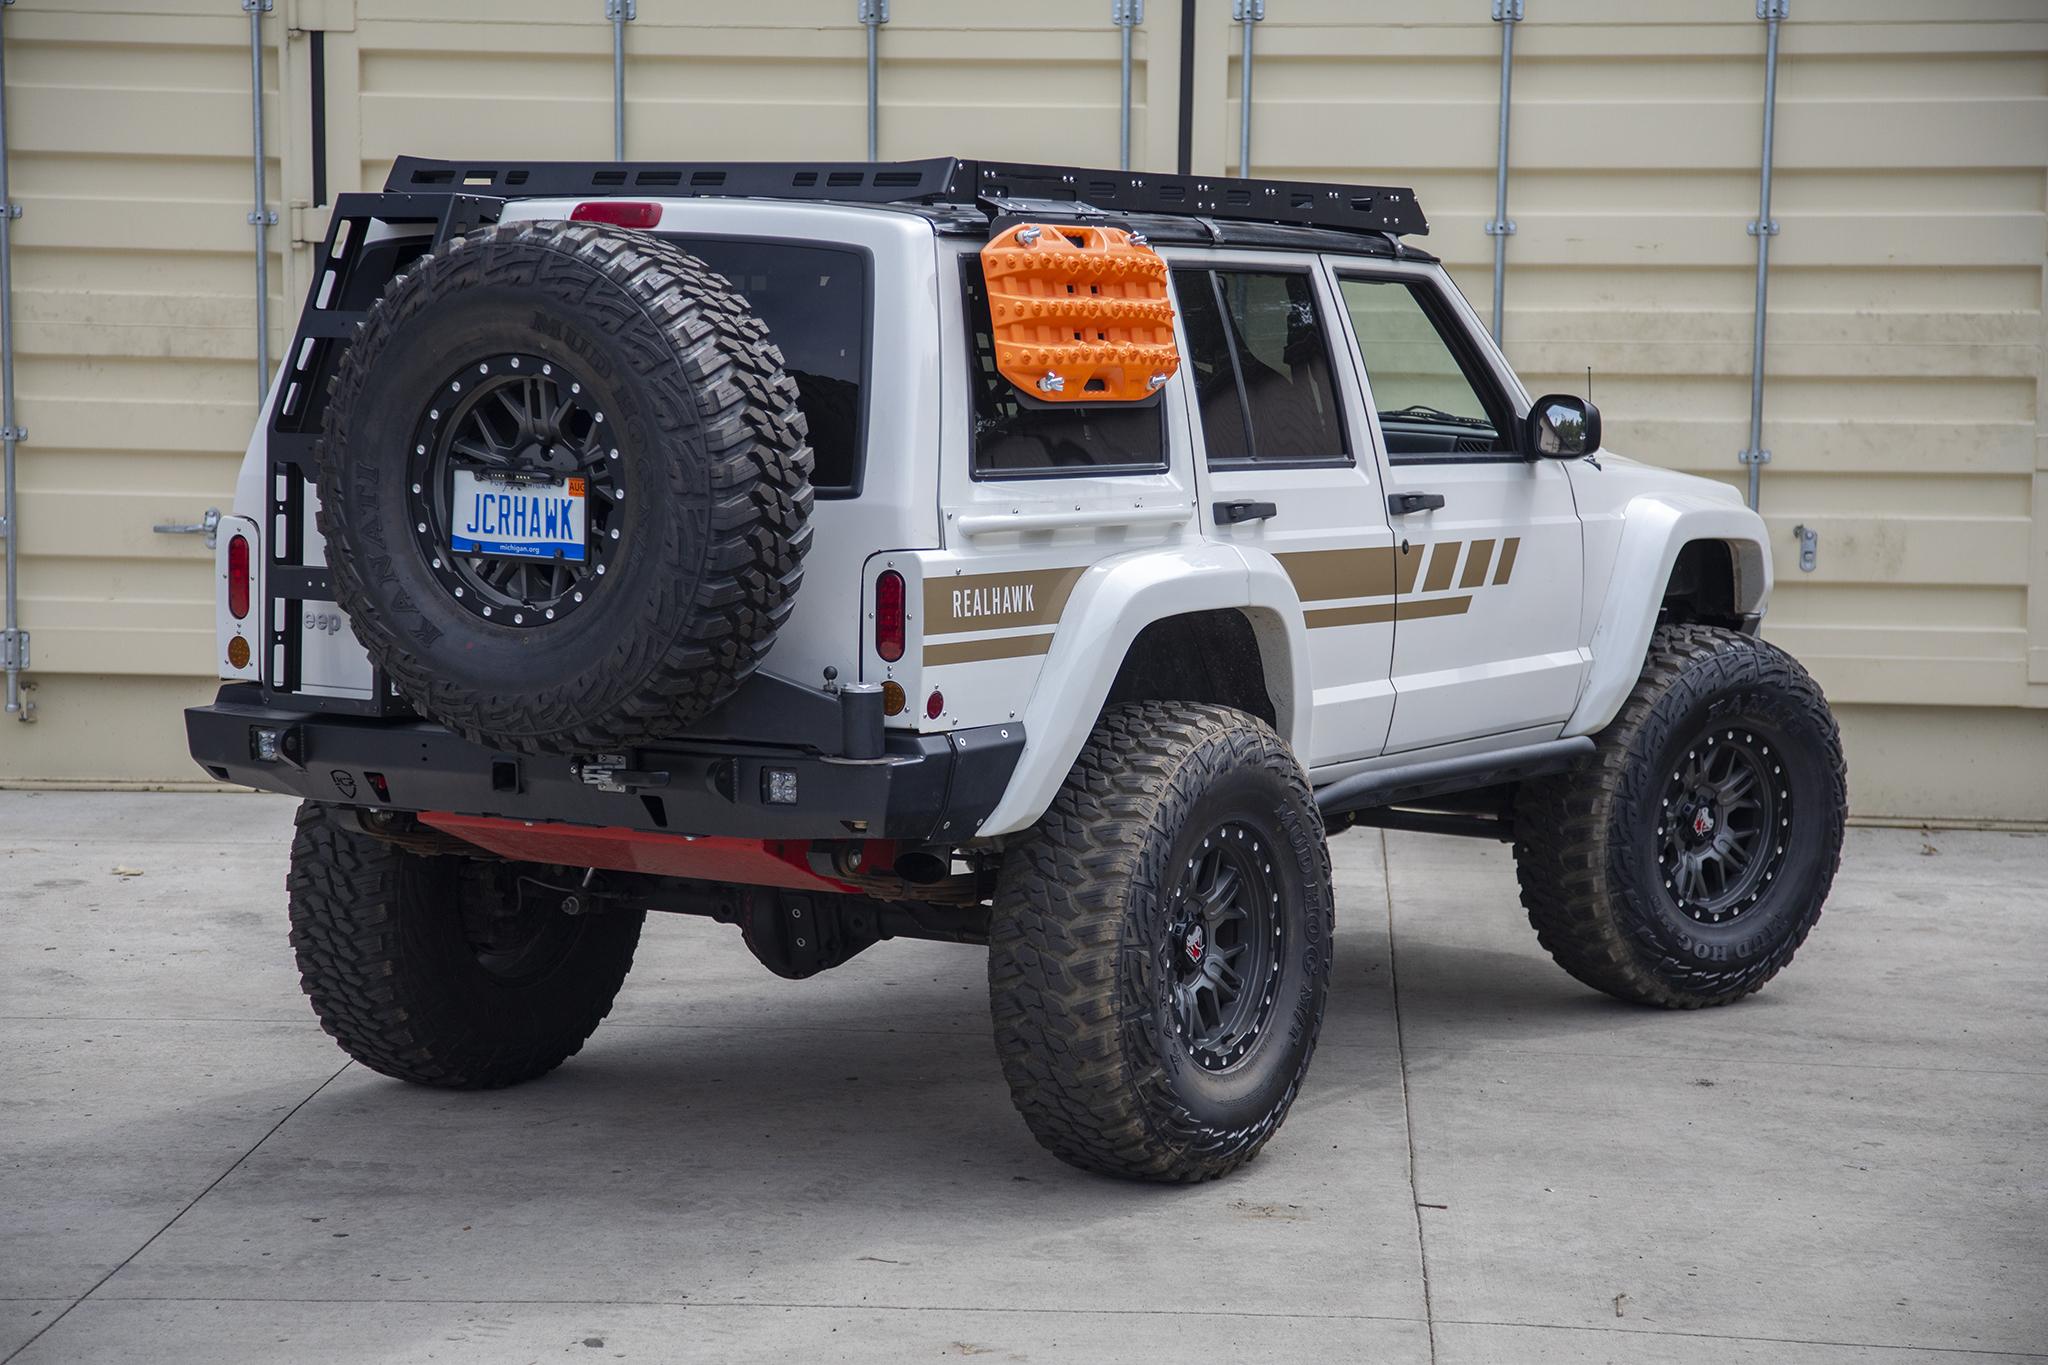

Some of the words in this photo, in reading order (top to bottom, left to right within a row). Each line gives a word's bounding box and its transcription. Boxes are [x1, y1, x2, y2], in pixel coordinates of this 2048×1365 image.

[530, 309, 612, 380] MUD
[466, 493, 574, 540] JCRHAWK
[353, 461, 445, 648] KANATI
[499, 543, 540, 554] michigan.org
[952, 584, 1035, 618] REALHAWK
[303, 611, 342, 636] eep
[1272, 797, 1314, 875] MUD
[1302, 879, 1322, 977] HOG
[1676, 932, 1729, 962] HOG
